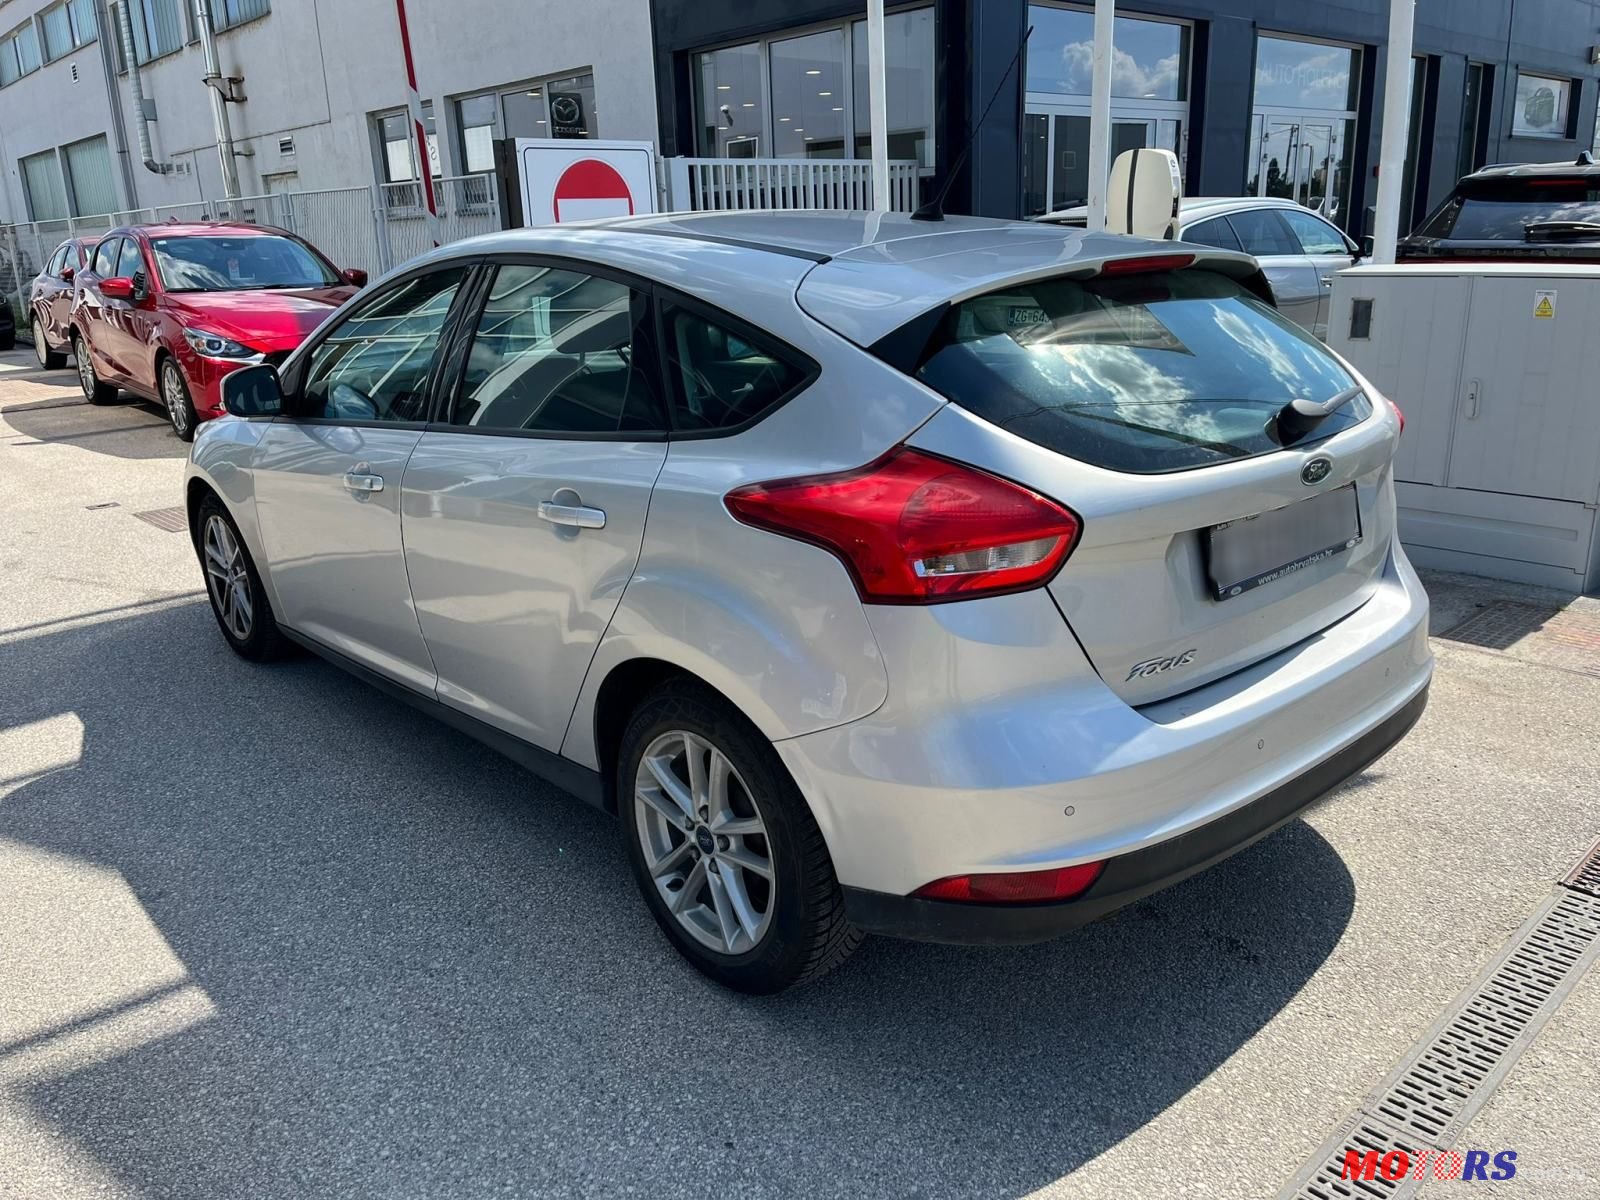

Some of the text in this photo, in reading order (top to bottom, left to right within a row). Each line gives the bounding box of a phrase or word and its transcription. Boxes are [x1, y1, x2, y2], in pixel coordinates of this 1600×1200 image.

[1260, 63, 1295, 85] AUTO
[1015, 310, 1027, 322] ZG
[1257, 548, 1334, 586] www.autohrvatska.hr
